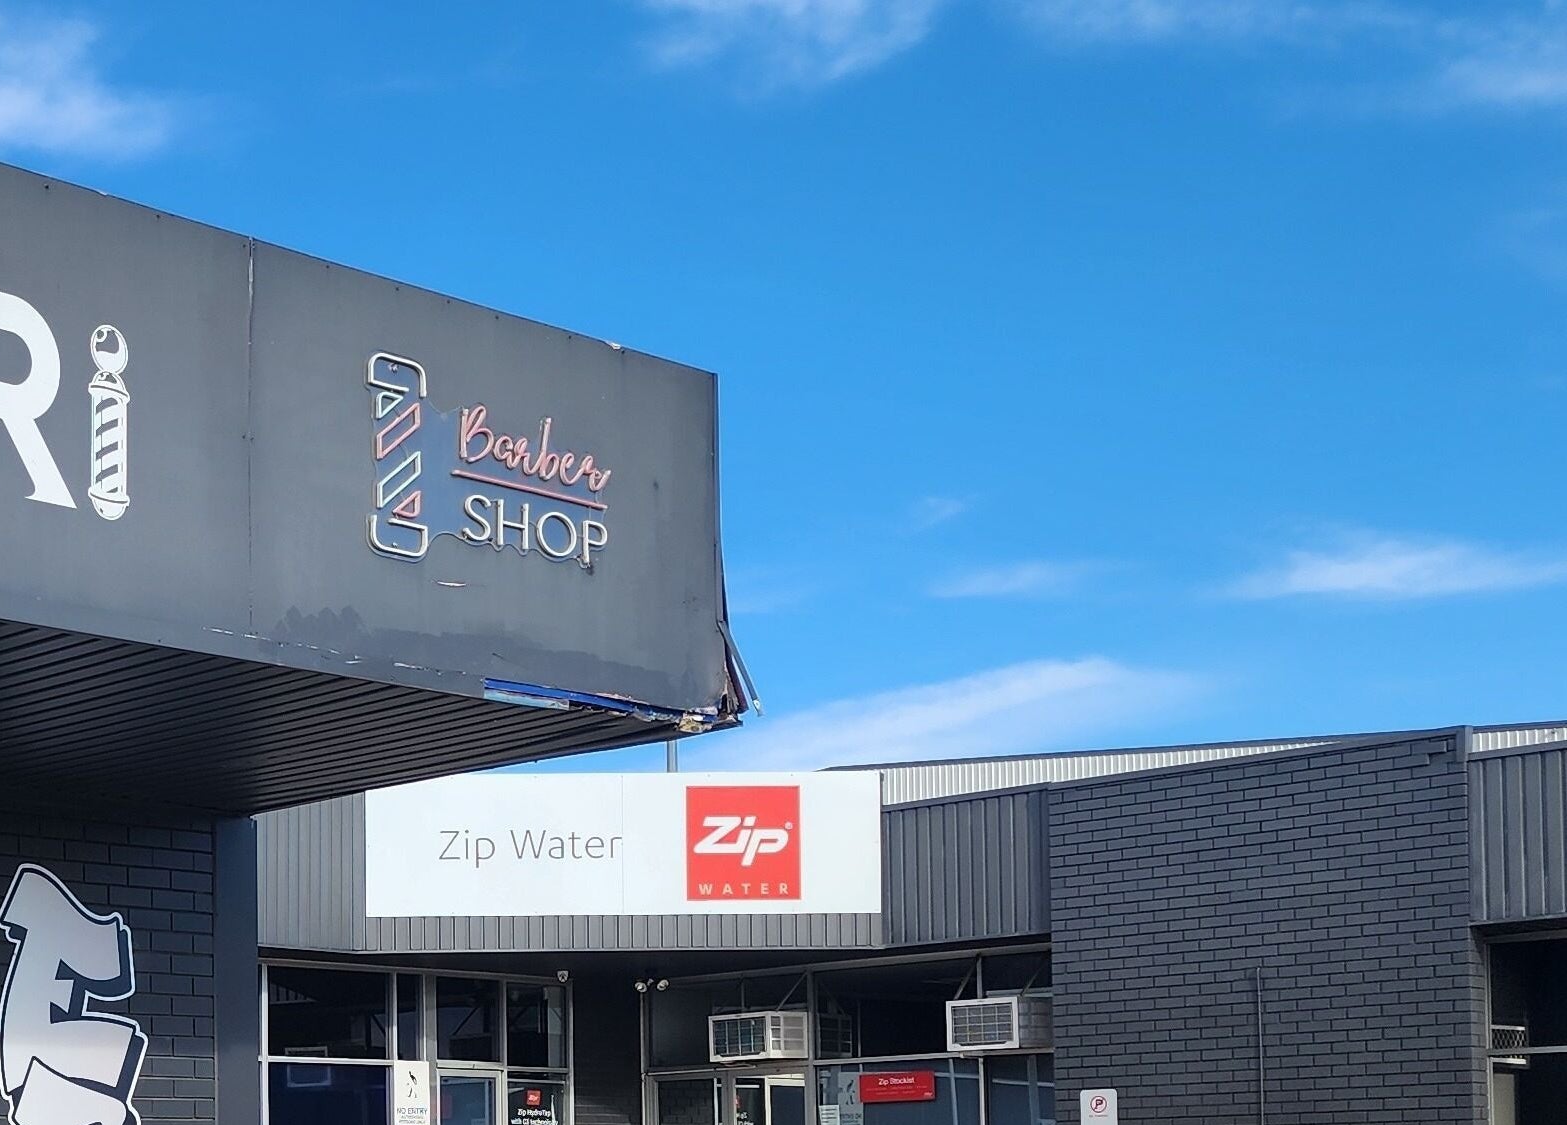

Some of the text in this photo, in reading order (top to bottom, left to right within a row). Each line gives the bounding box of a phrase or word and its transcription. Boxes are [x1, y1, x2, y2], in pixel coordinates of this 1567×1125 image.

[460, 402, 612, 493] Barber
[462, 494, 609, 566] SHOP
[438, 829, 623, 869] Zip Water
[698, 883, 789, 896] WATER
